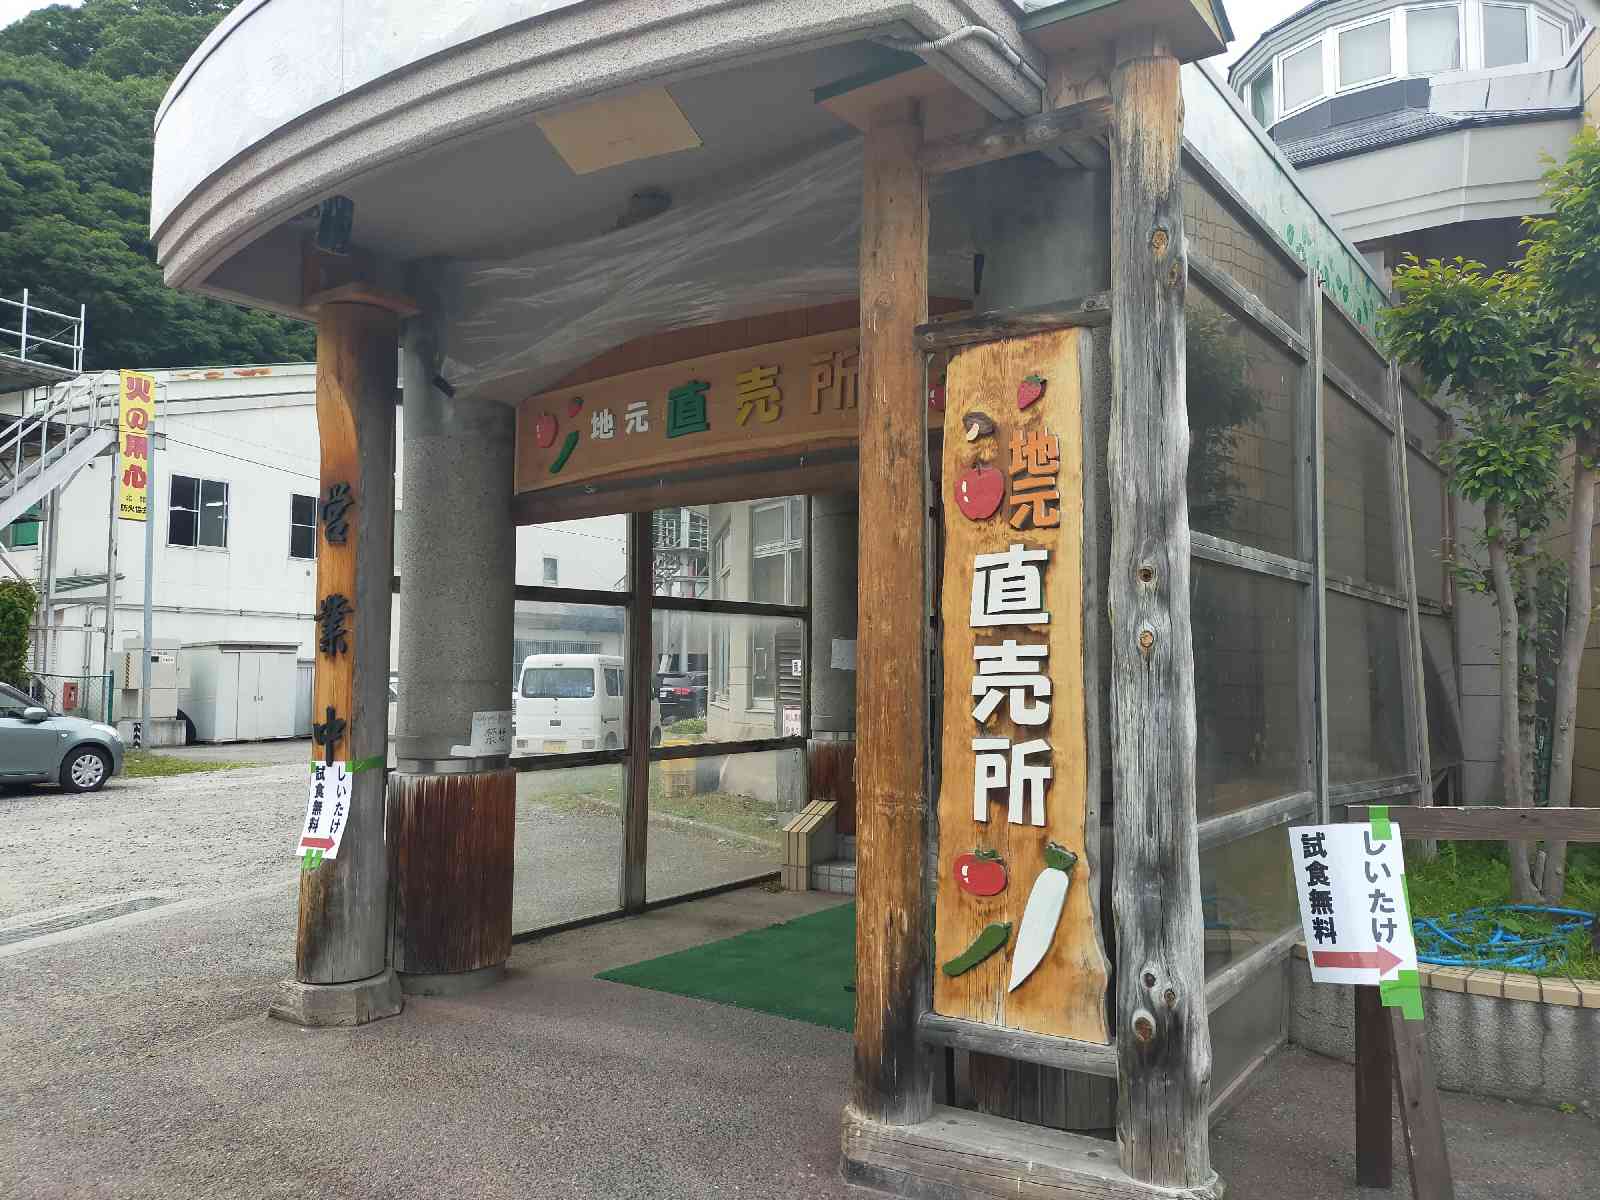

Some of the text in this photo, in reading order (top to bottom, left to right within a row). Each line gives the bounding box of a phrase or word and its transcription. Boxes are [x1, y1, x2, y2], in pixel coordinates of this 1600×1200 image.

[122, 376, 151, 489] 火の用心
[1008, 427, 1060, 529] 地元
[313, 481, 354, 767] 営業中
[969, 543, 1053, 827] 直売所
[307, 765, 326, 833] 試食無料
[329, 765, 346, 834] しいたけ
[1300, 831, 1337, 945] 試食無料
[1363, 830, 1398, 944] しいたけ
